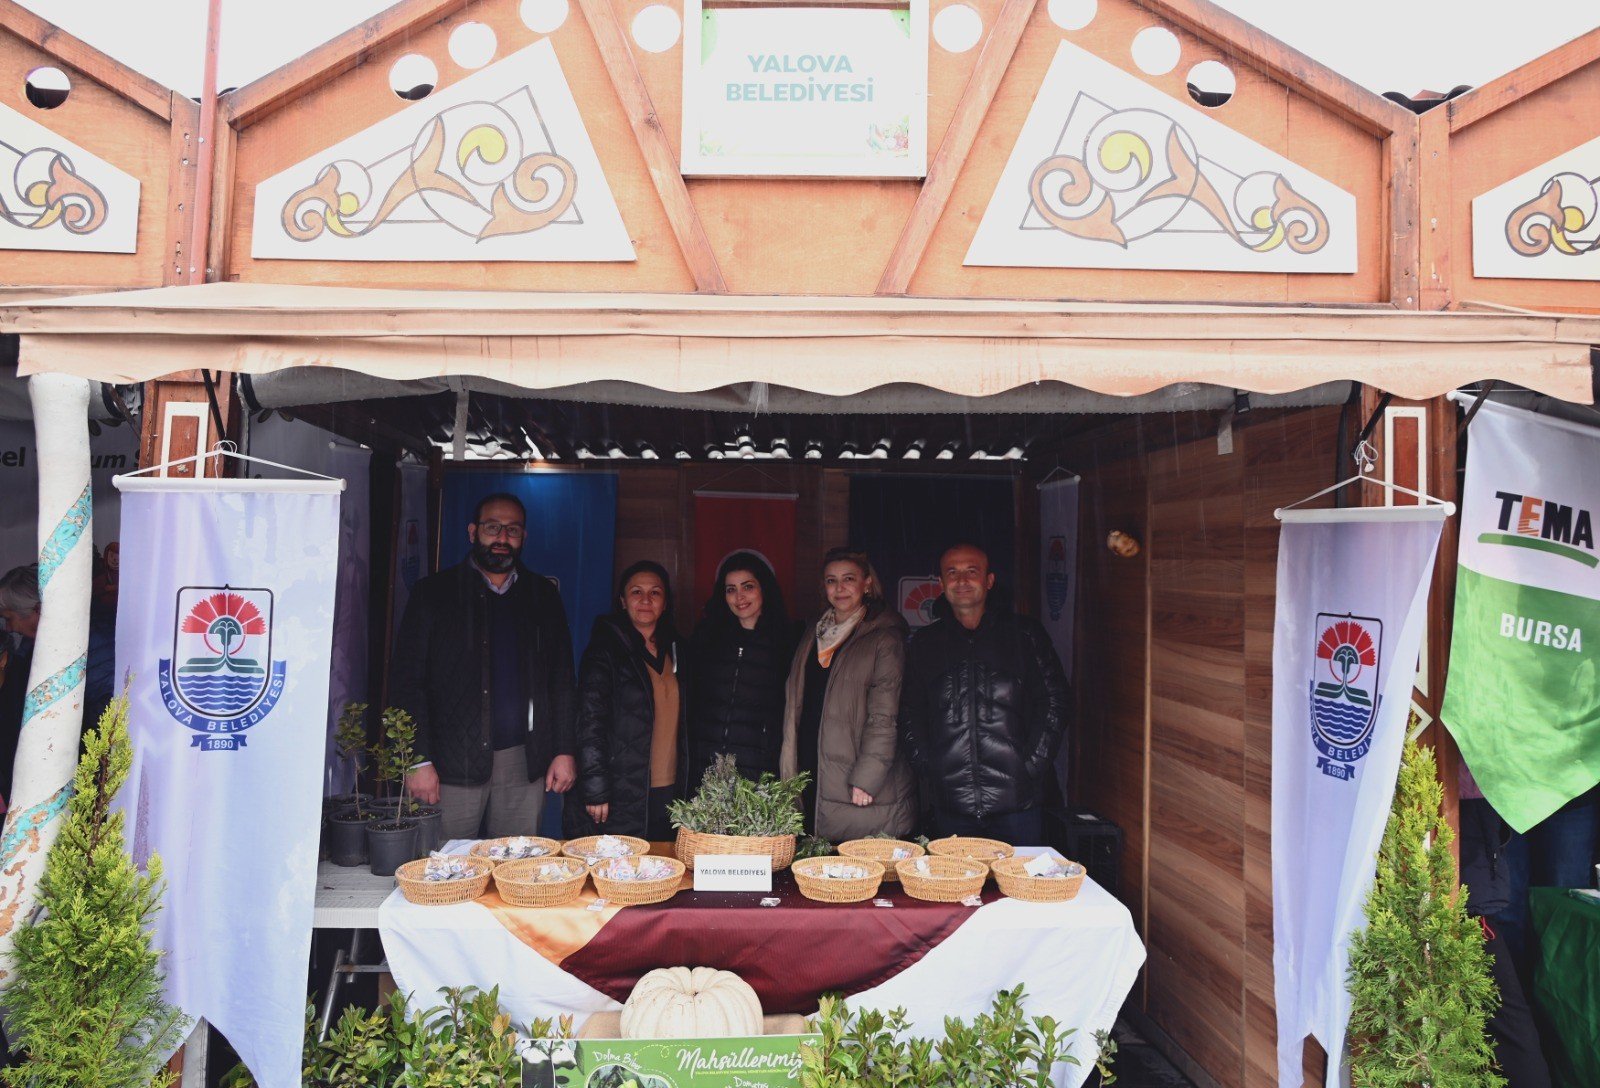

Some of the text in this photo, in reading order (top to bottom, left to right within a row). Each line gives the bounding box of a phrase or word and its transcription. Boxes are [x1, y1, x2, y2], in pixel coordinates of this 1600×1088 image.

[747, 54, 853, 73] YALOVA
[726, 77, 874, 102] BELEDİYESİ
[1495, 490, 1595, 550] TEMA
[1500, 612, 1582, 653] BURSA
[160, 669, 194, 725] YALOVA
[207, 740, 234, 749] 1890
[1327, 764, 1346, 778] 1890
[700, 868, 727, 876] YALOVA
